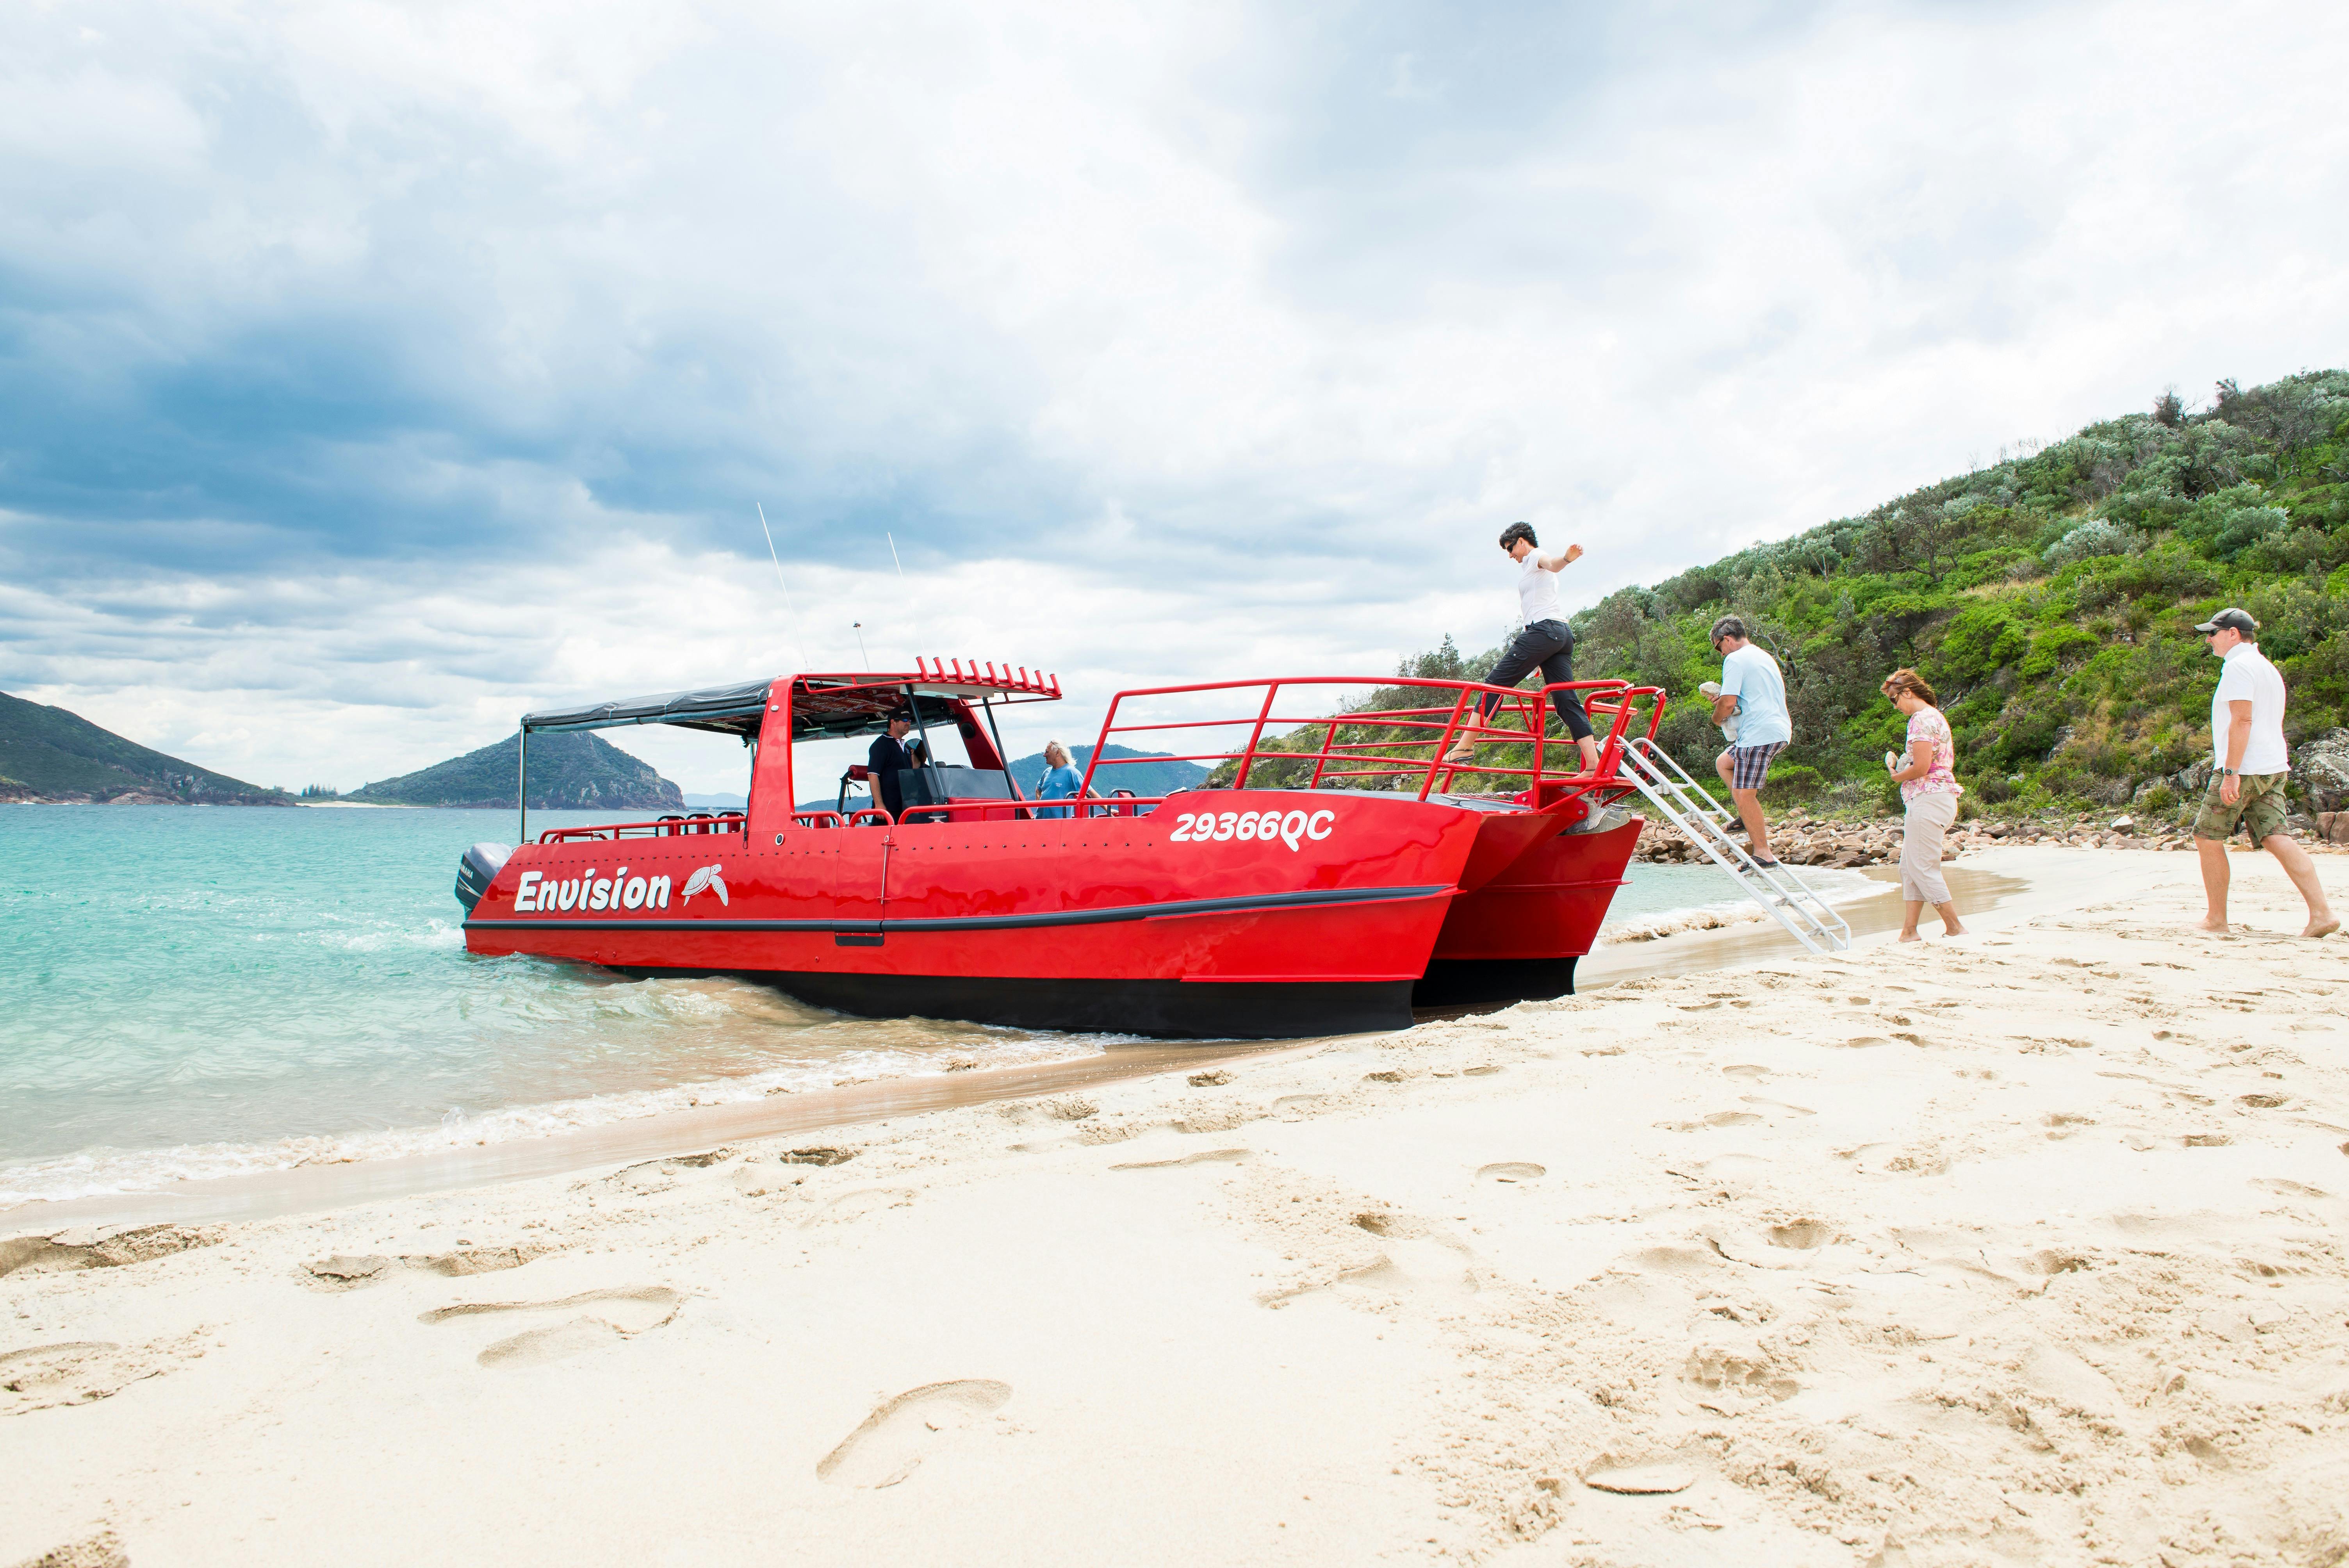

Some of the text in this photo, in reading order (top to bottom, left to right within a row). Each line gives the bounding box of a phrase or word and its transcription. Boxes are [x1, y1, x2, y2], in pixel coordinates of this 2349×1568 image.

[1169, 809, 1335, 852] 29366QC
[460, 863, 474, 880] AMAHA
[514, 866, 671, 912] Envision
